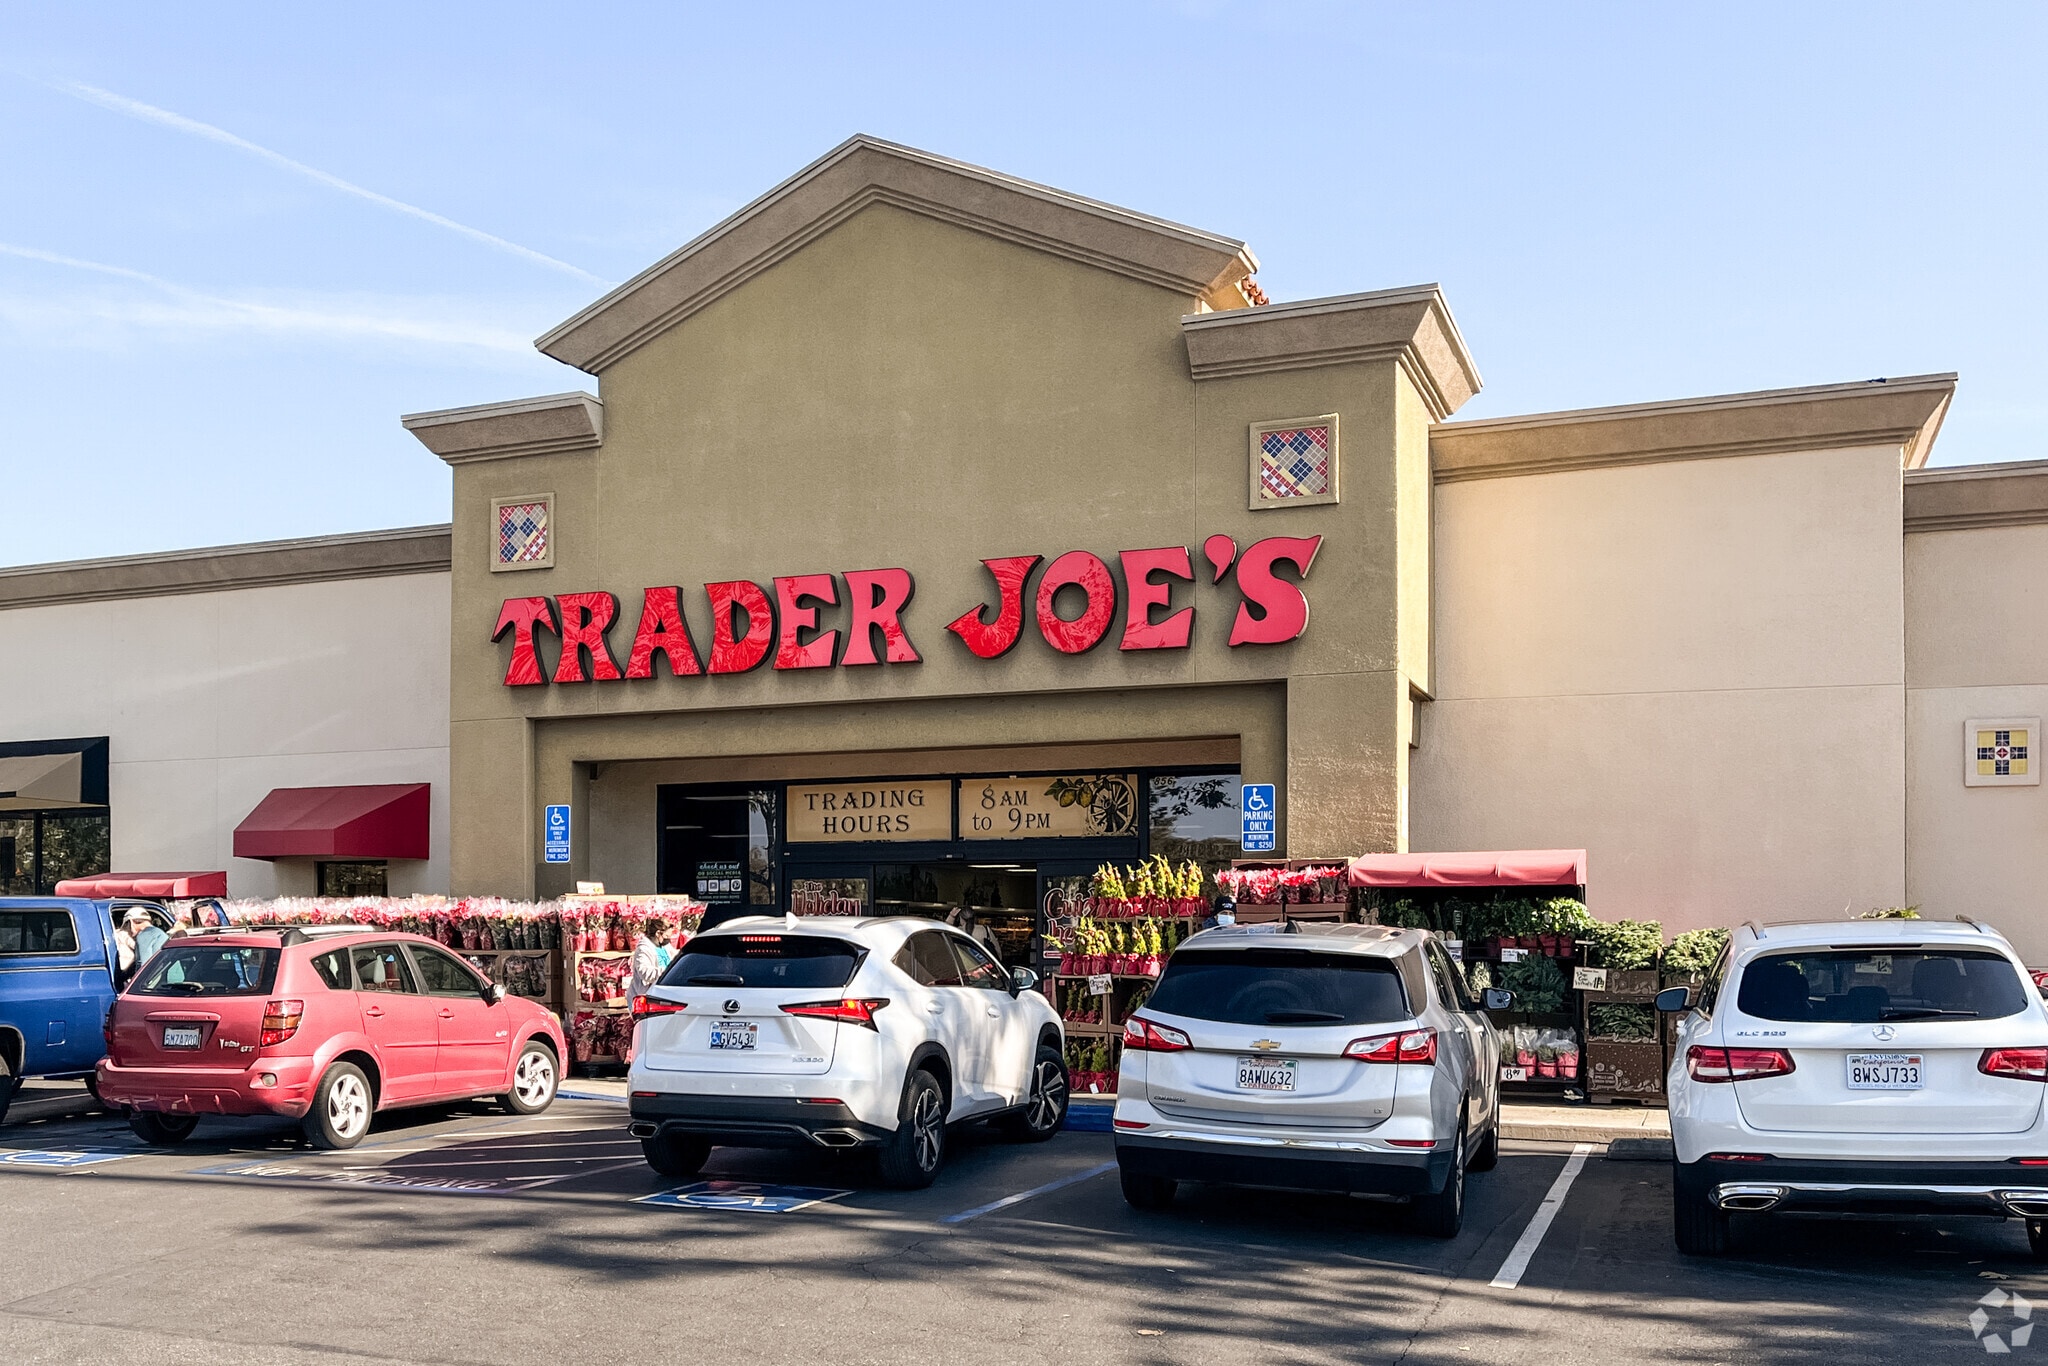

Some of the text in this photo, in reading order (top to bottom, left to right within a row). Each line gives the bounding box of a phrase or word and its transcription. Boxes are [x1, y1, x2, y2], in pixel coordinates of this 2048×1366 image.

[491, 534, 1324, 686] TRADER JOE'S
[1154, 776, 1173, 786] 856
[804, 788, 926, 812] TRADING
[981, 783, 1029, 810] 8 AM
[972, 808, 1051, 833] to 9 PM
[1244, 811, 1273, 821] PARKING
[822, 813, 910, 835] HOURS
[1249, 821, 1268, 831] ONLY
[1244, 841, 1273, 849] FINE $250
[699, 862, 718, 870] check
[728, 862, 741, 870] out
[791, 889, 861, 916] Holiday
[720, 1032, 751, 1046] GV543
[1249, 1061, 1284, 1070] California
[1863, 1059, 1905, 1067] California
[1239, 1068, 1292, 1086] 8AWU632
[1853, 1067, 1918, 1083] 8WSJ733
